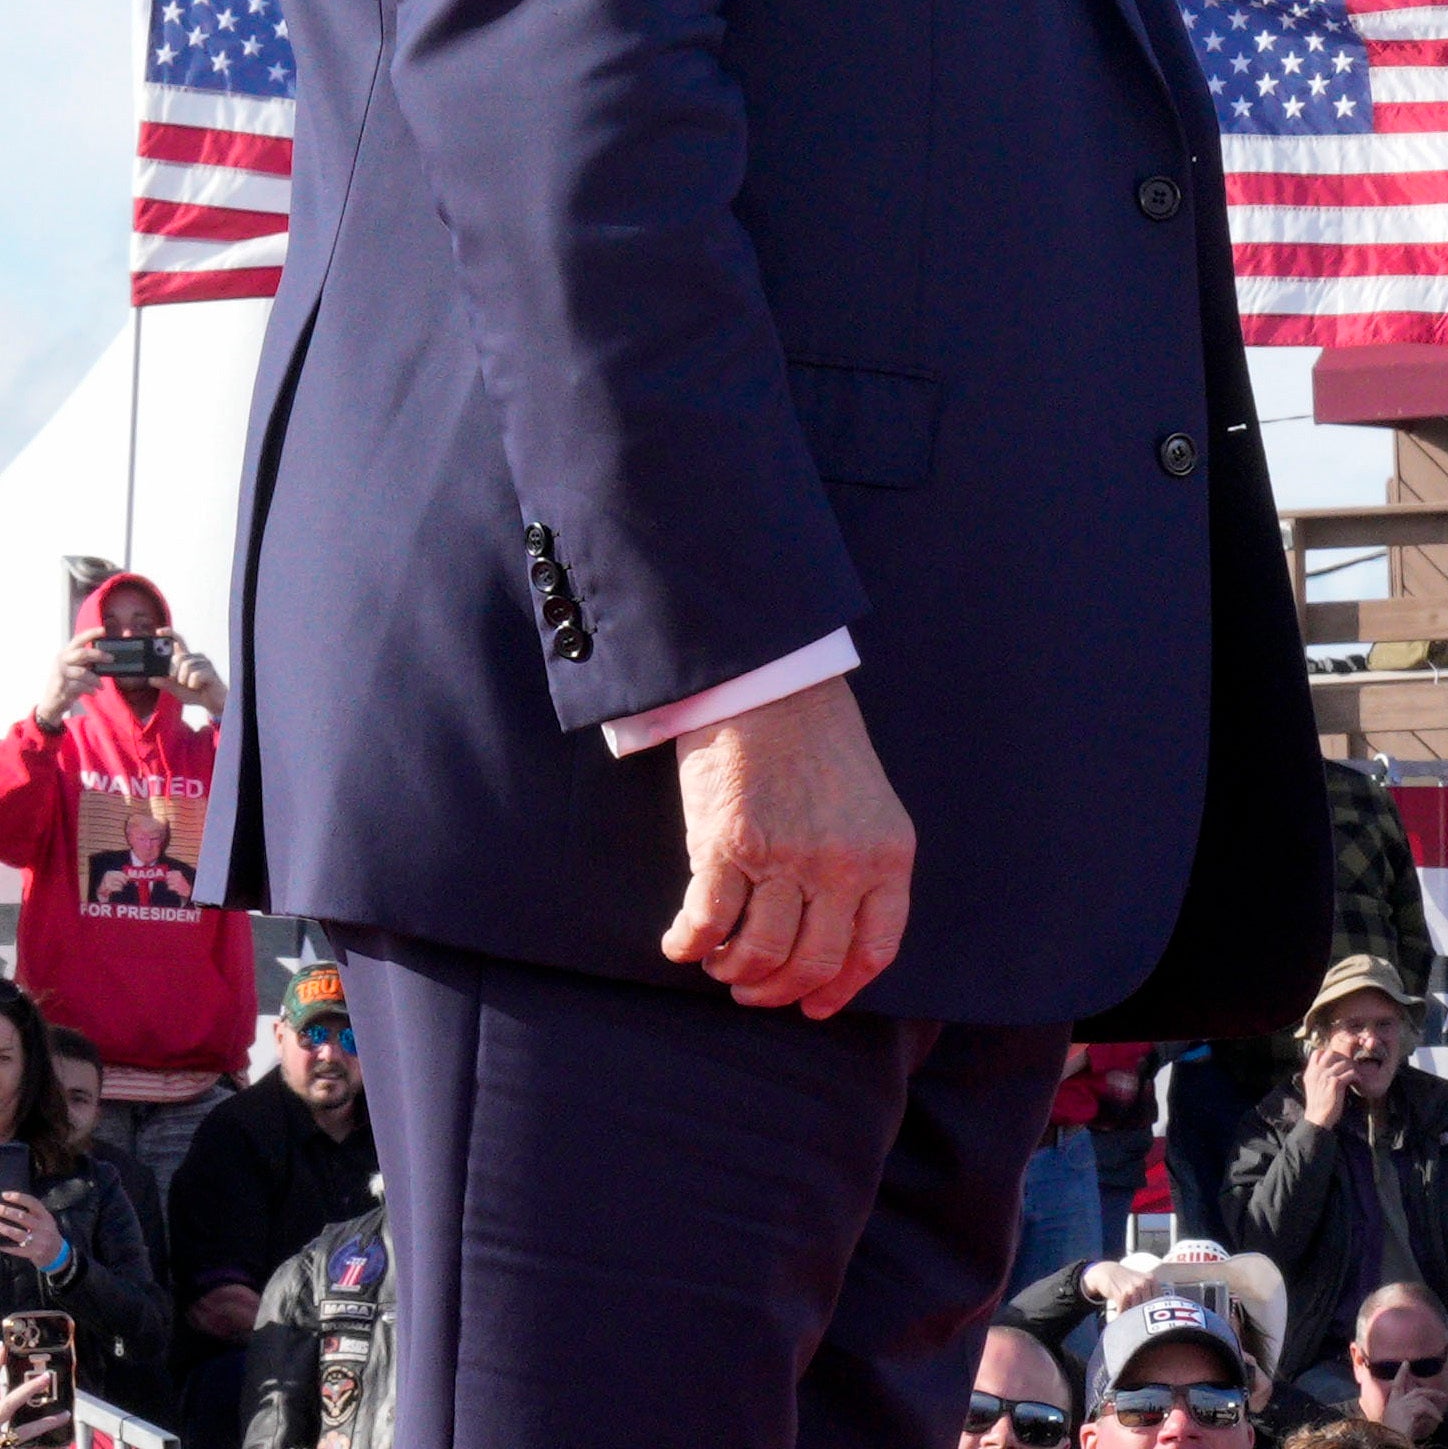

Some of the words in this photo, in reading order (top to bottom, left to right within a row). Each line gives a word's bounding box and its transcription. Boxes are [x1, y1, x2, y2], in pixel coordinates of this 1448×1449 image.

[80, 770, 204, 799] WANTED
[127, 868, 166, 880] MAGA
[80, 904, 114, 919] FOR
[296, 976, 341, 1004] TRU
[323, 1303, 371, 1316] MAGA
